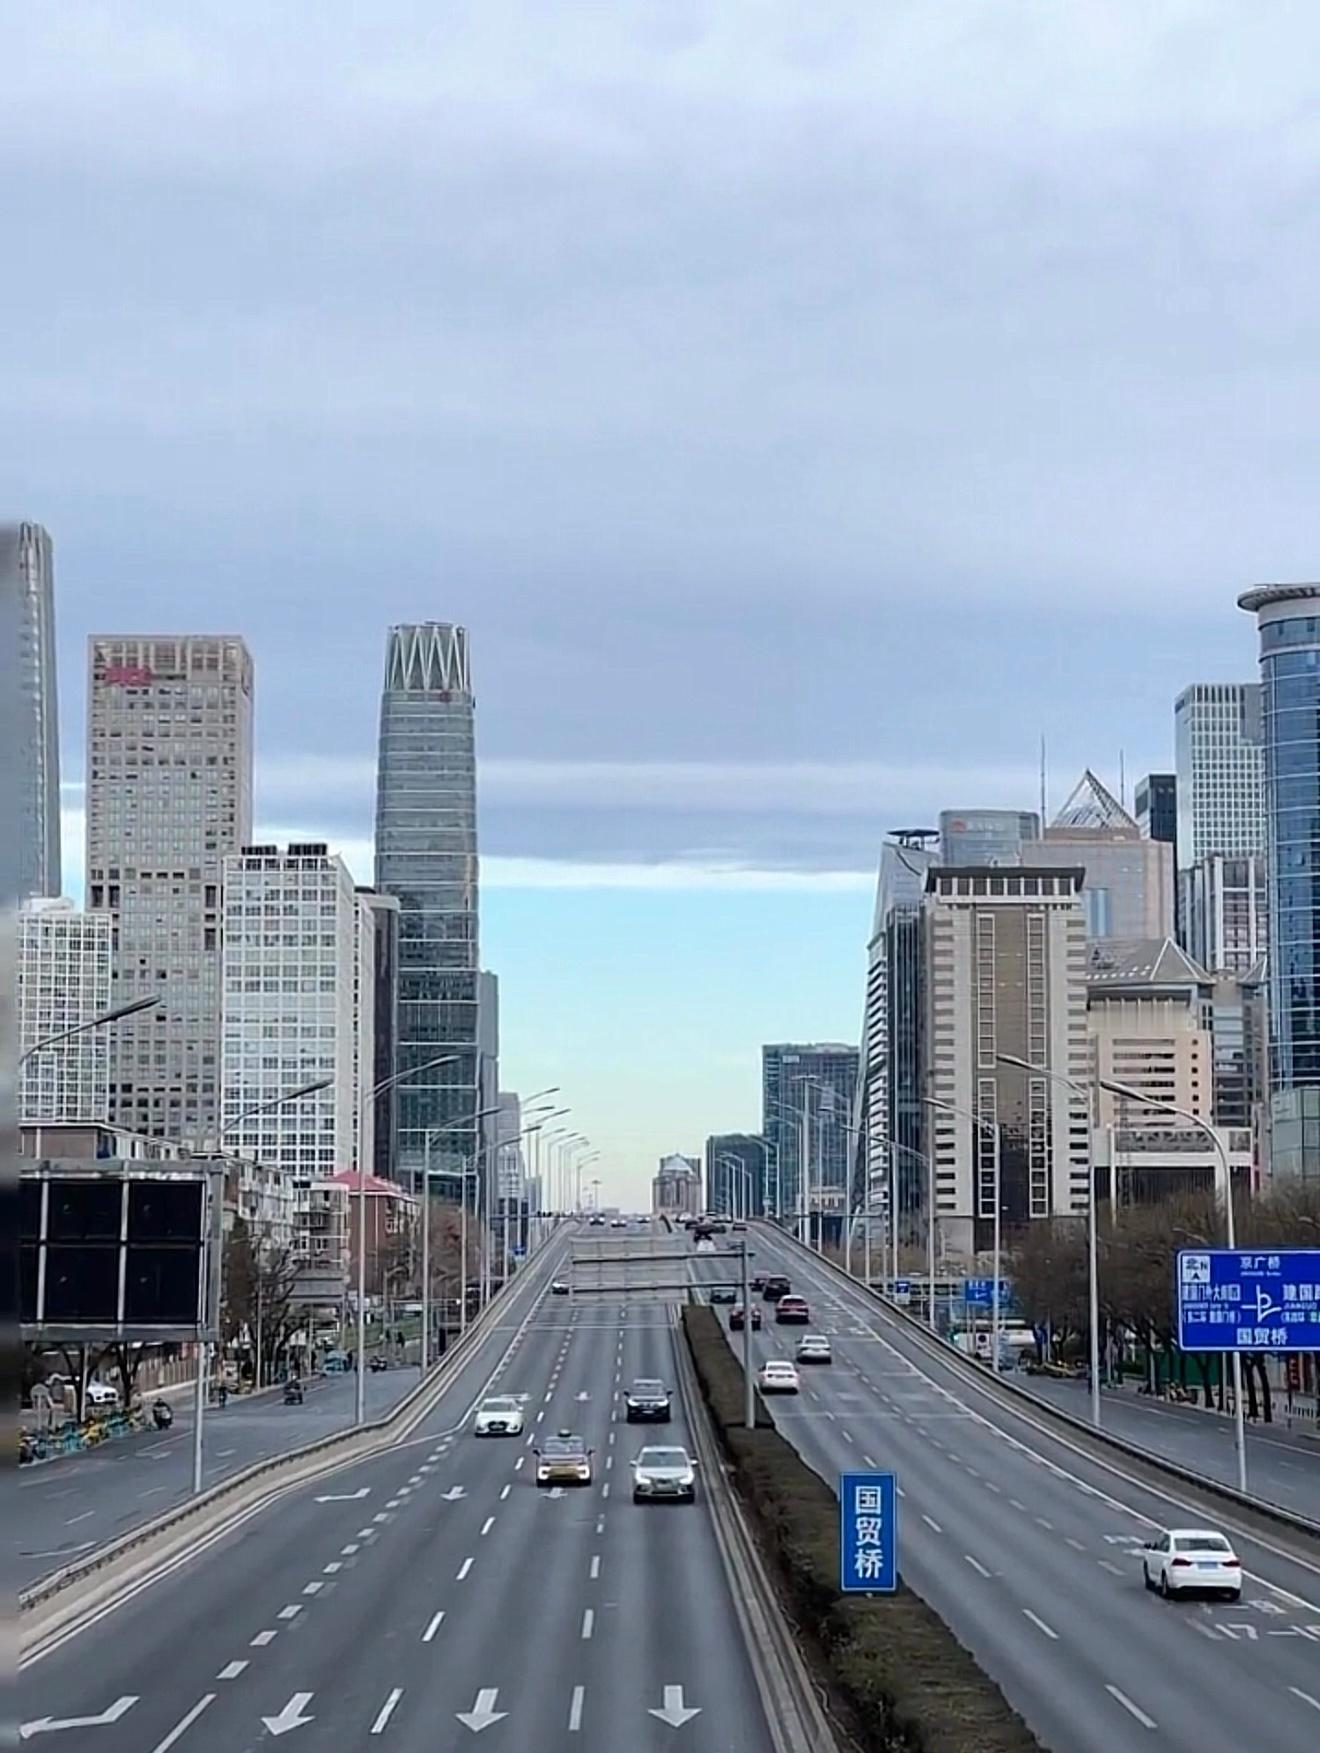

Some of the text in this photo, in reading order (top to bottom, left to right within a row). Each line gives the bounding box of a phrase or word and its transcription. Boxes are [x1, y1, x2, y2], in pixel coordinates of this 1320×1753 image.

[1237, 1327, 1288, 1345] 国贸桥
[855, 1485, 884, 1579] 国贸桥
